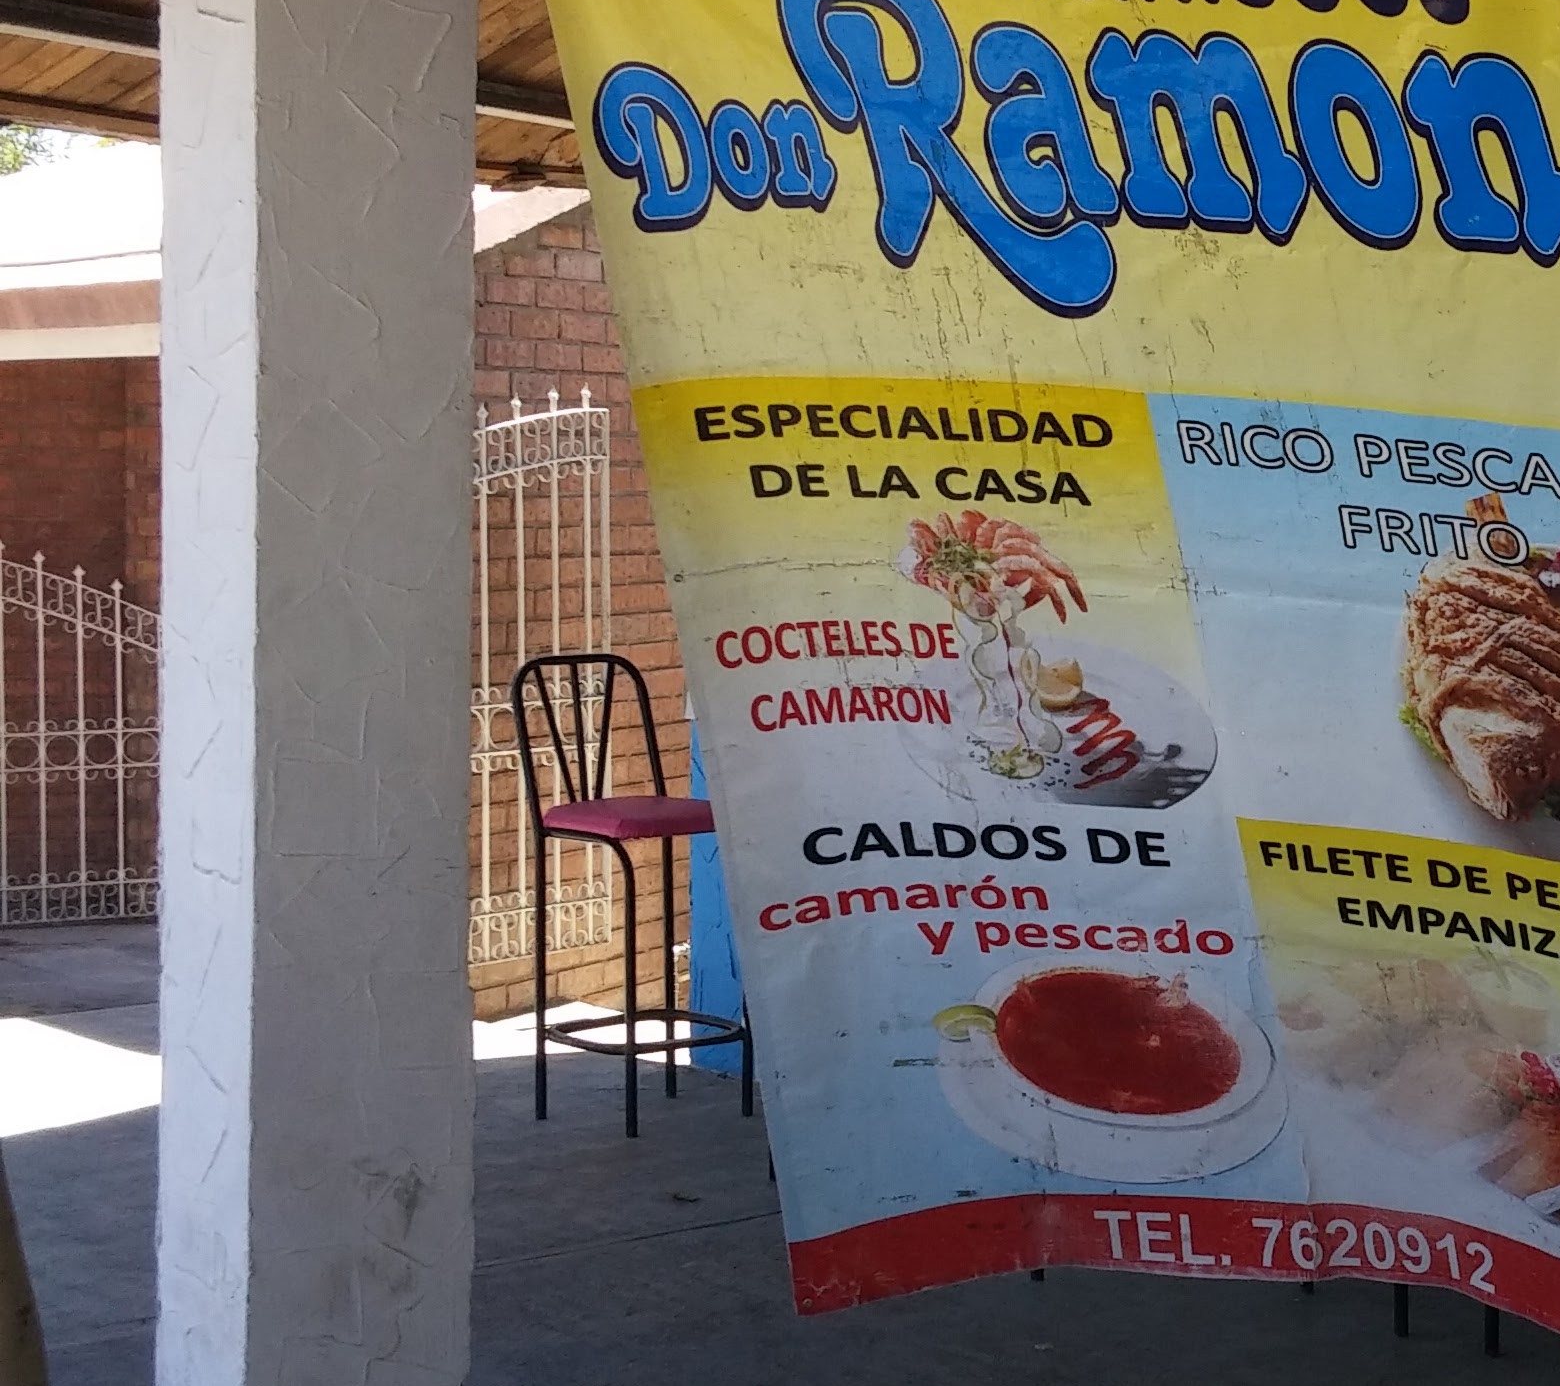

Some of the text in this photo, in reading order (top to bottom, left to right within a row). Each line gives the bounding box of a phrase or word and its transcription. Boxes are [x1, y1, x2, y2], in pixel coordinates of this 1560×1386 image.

[593, 62, 838, 232] Don
[694, 404, 1113, 448] ESPECIALIDAD
[1177, 420, 1334, 474] RICO
[750, 464, 1092, 506] DE LA CASA
[1339, 505, 1530, 566] FRITO
[715, 620, 959, 669] COCTELES DE
[751, 686, 952, 732] CAMARON
[803, 822, 1171, 867] CALDOS DE
[1259, 840, 1412, 884] FILETE
[1428, 859, 1492, 895] DE
[758, 874, 1050, 931] camarón
[918, 919, 1235, 956] y pescado
[1094, 1210, 1497, 1294] TEL. 7620912
